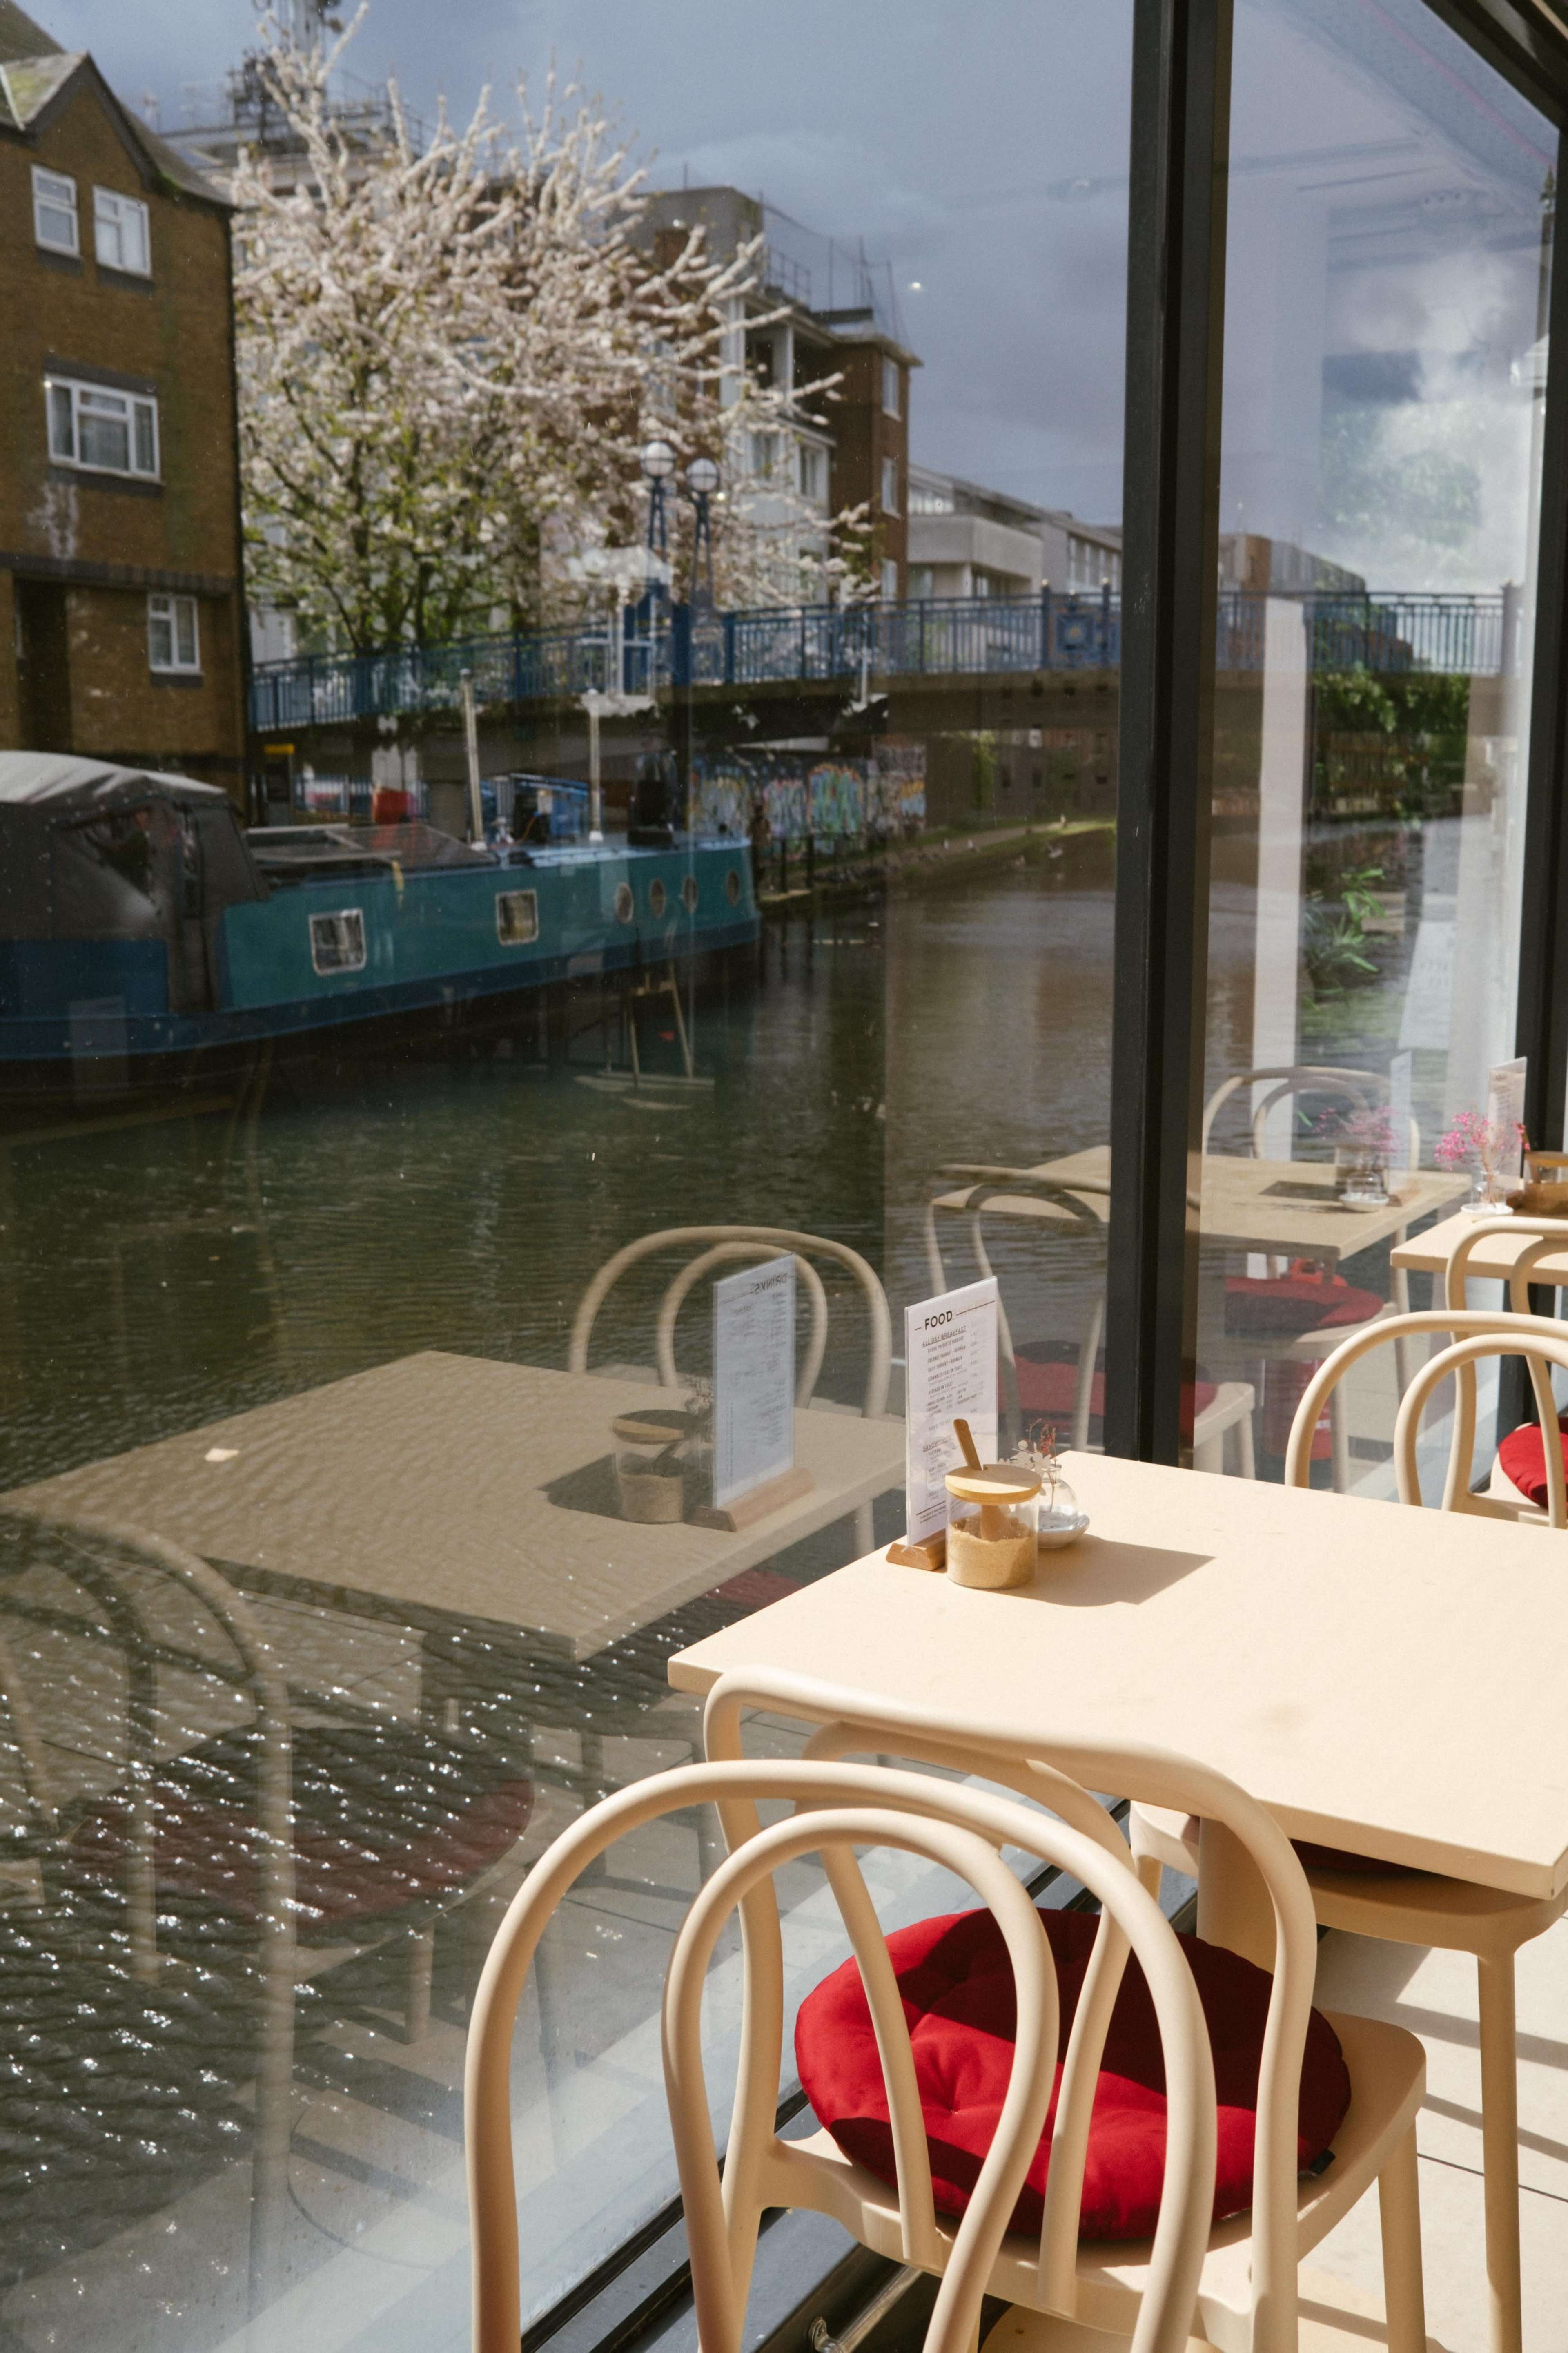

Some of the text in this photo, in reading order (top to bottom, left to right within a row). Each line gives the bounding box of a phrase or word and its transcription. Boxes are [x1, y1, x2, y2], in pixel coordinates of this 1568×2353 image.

[925, 1310, 952, 1330] FOOD
[922, 1338, 931, 1347] ALL
[941, 1326, 966, 1340] BREAKFAST
